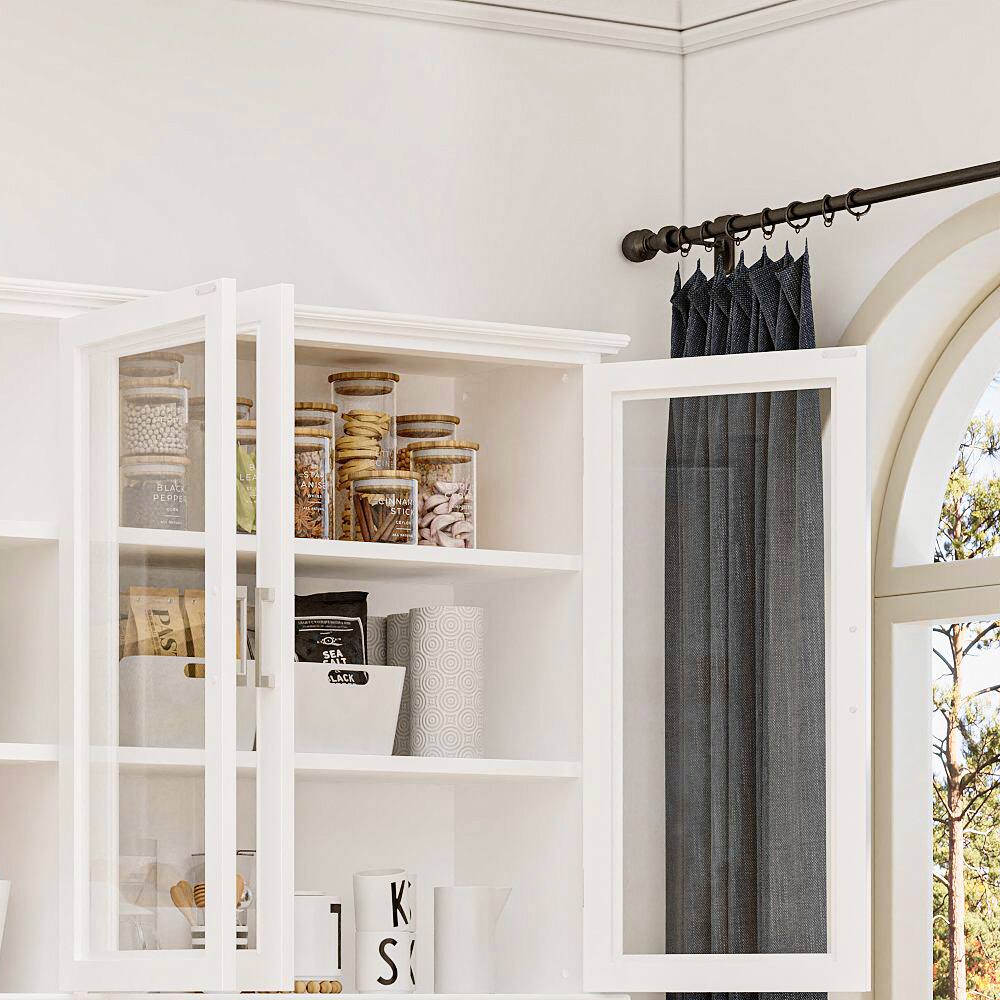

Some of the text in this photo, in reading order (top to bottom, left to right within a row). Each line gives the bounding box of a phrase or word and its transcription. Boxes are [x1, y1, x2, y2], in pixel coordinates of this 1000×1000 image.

[153, 493, 184, 503] PEPPE
[322, 649, 343, 659] SEA
[327, 673, 355, 683] LACK
[390, 880, 409, 928] K
[376, 937, 398, 986] S
